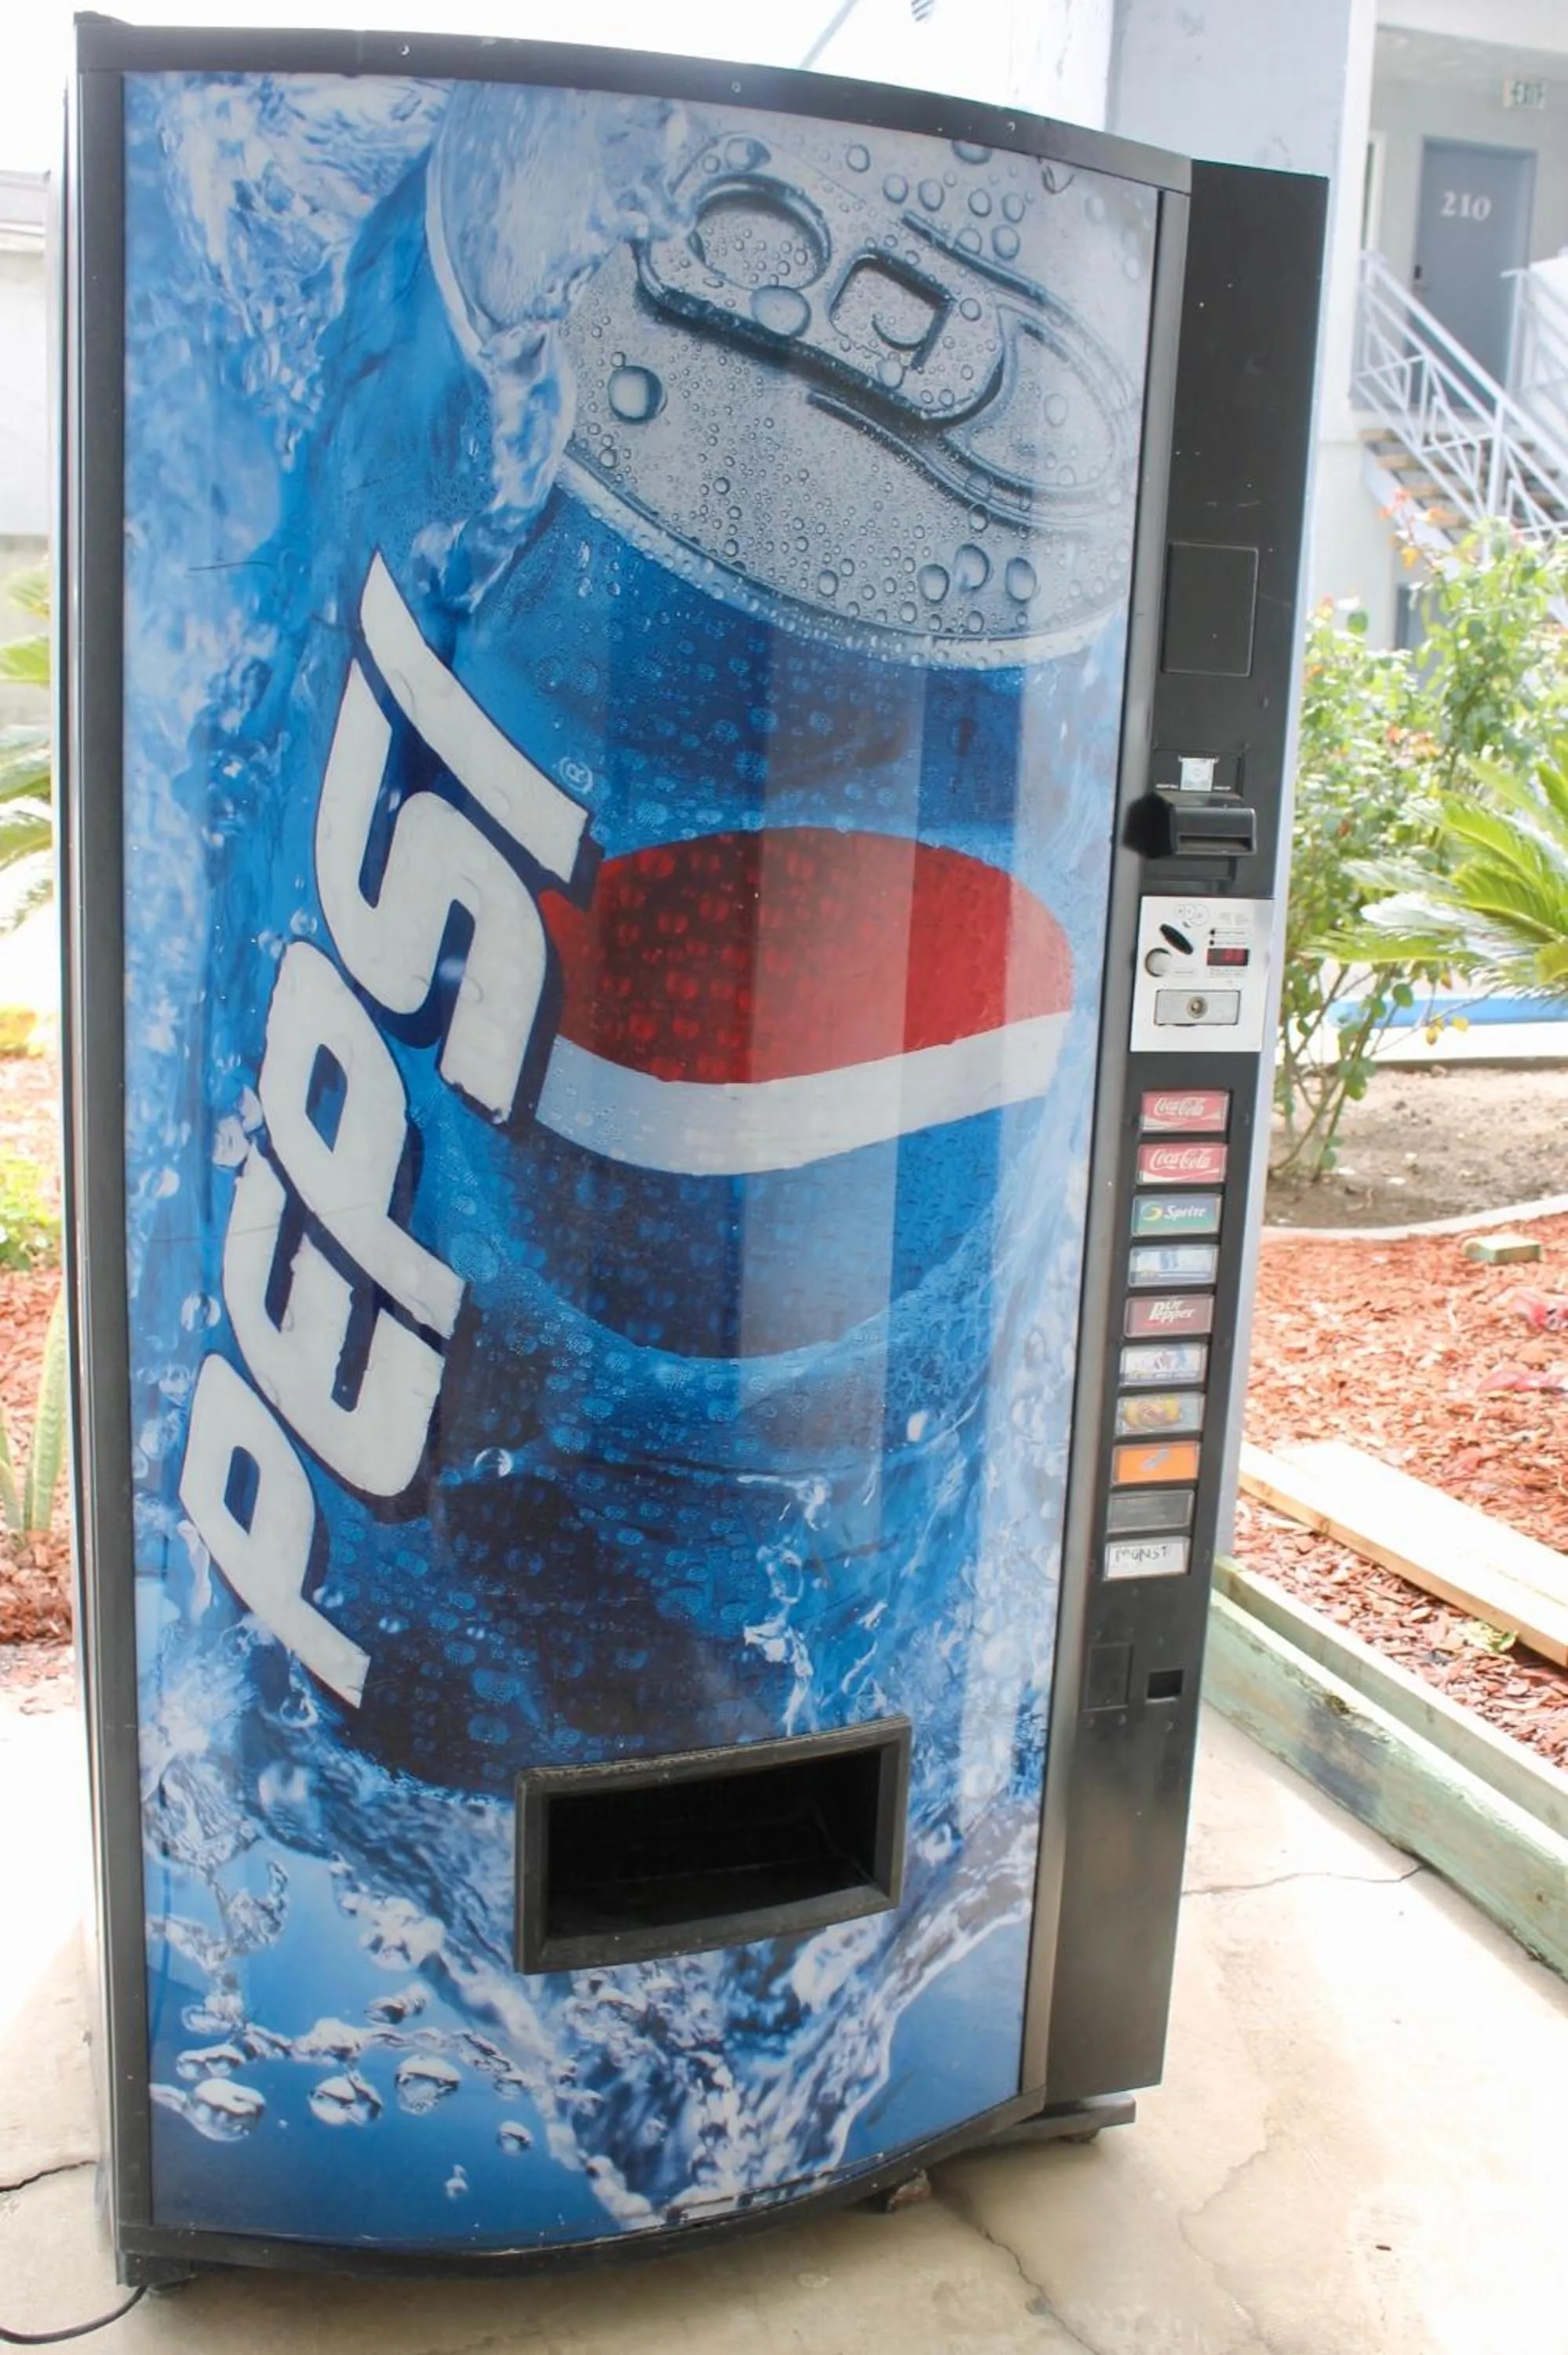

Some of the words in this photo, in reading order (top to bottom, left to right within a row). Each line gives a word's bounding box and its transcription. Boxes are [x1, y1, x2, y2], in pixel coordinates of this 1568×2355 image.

[1440, 191, 1492, 221] 210
[179, 550, 589, 1709] PEPSI
[1163, 1204, 1206, 1221] Sprite
